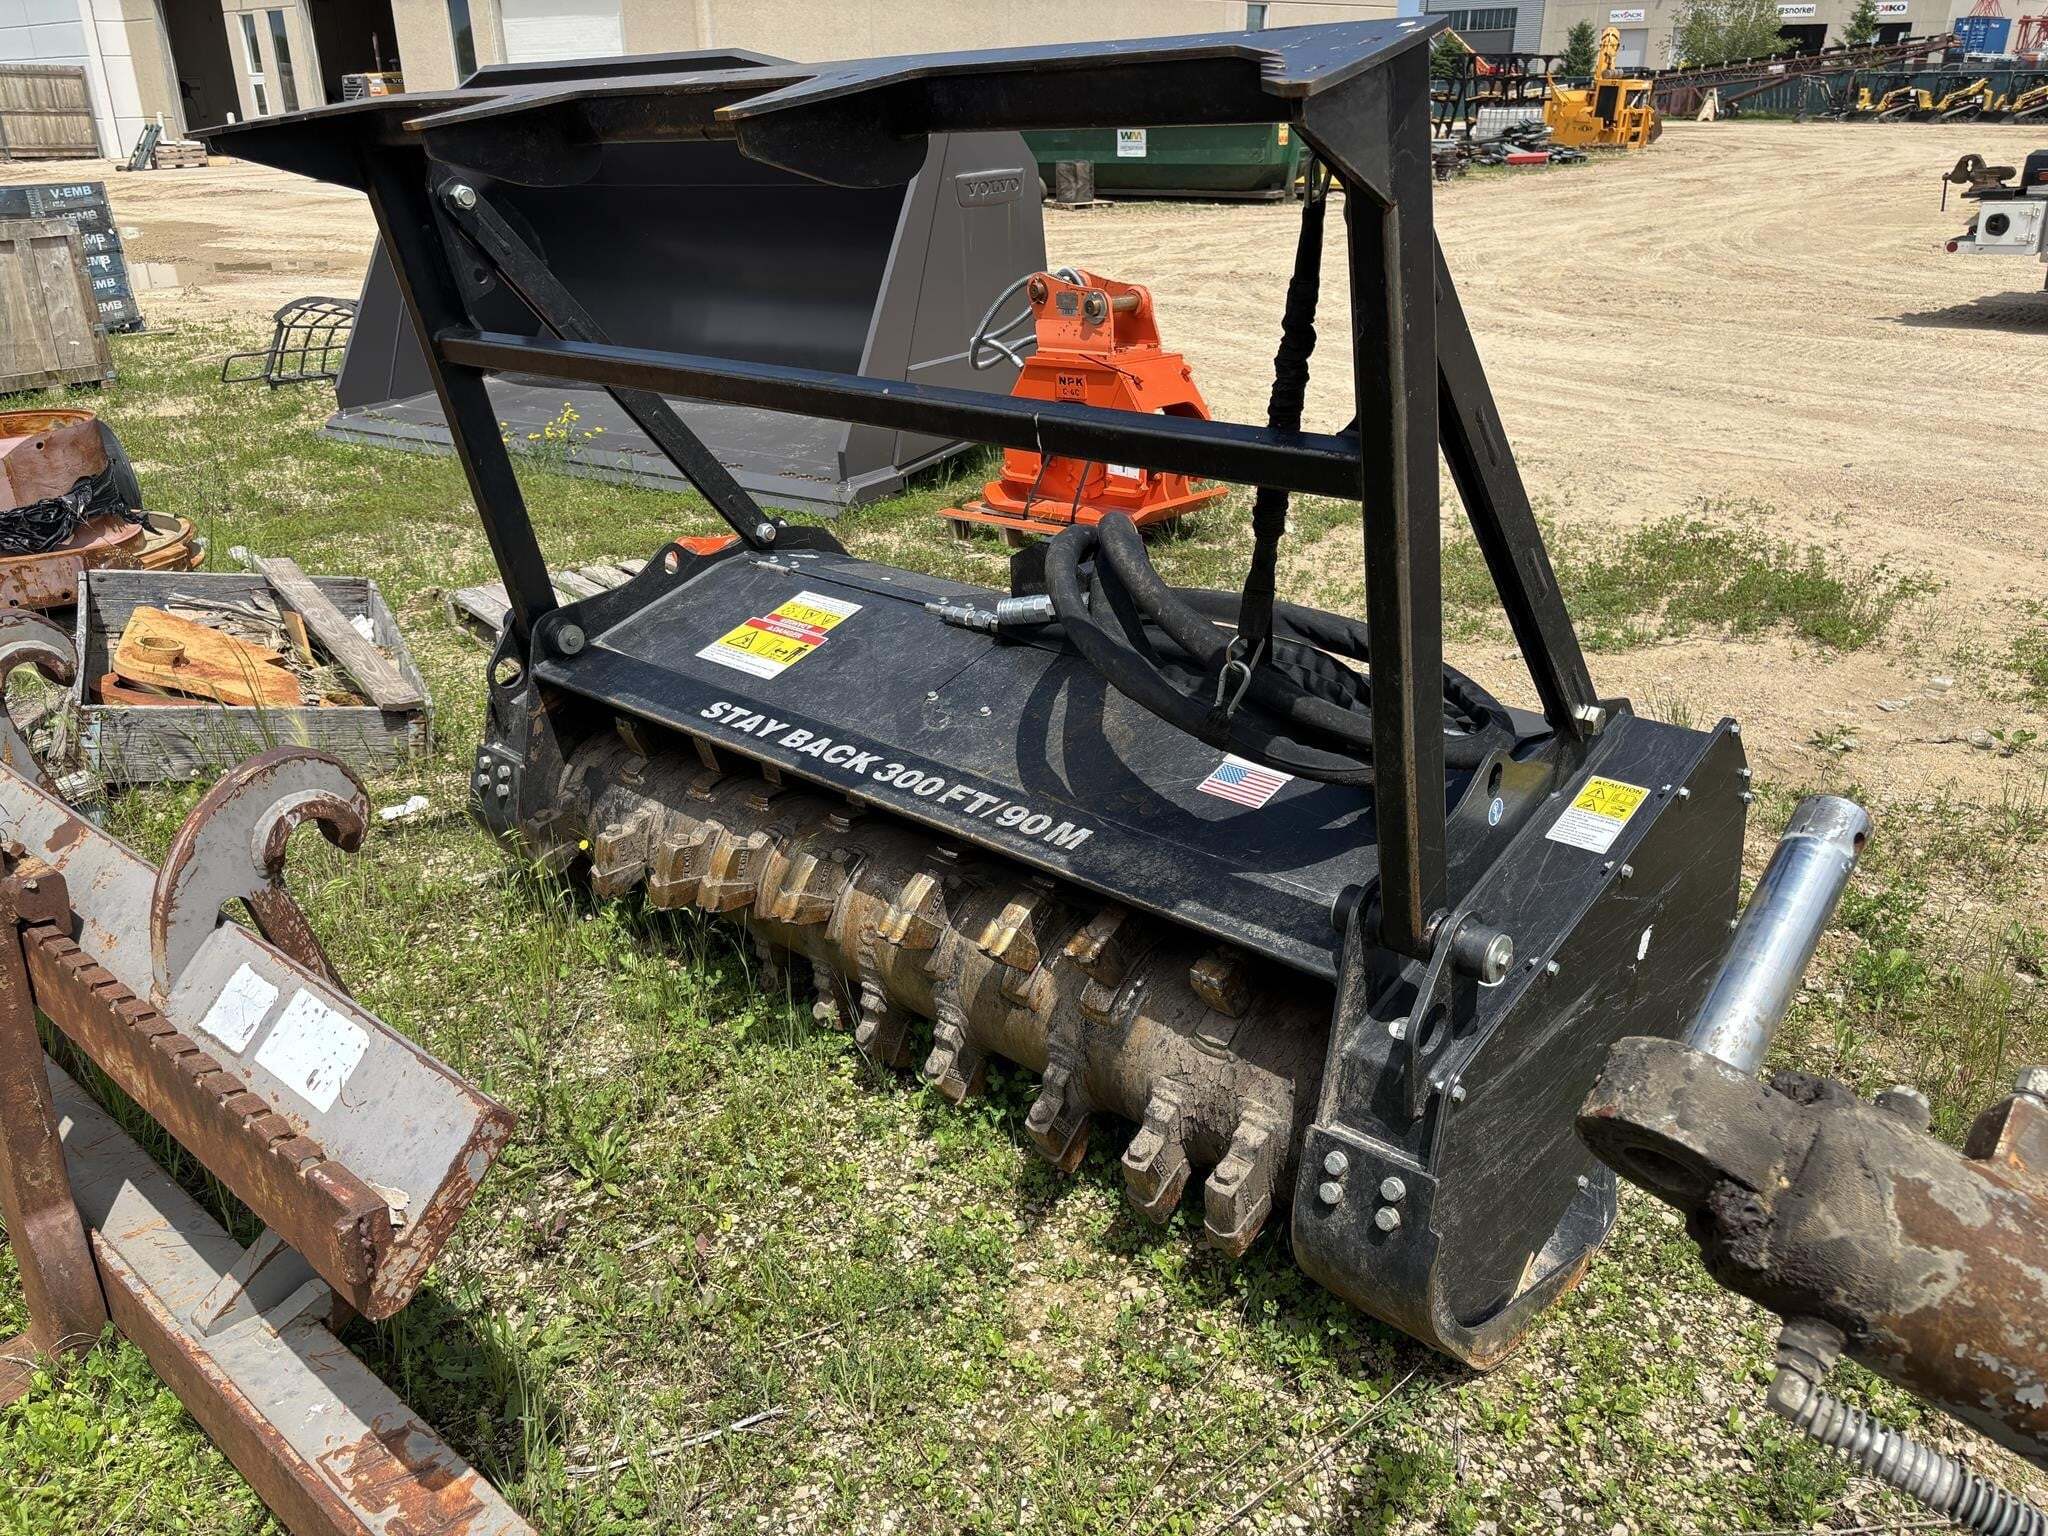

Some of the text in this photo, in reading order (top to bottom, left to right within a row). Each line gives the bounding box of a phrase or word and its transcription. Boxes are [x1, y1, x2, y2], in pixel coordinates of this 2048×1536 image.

[50, 185, 93, 199] V-EMB
[965, 178, 1019, 197] VOLVO
[1059, 376, 1083, 386] NPK
[700, 701, 791, 738] STAY
[778, 728, 885, 775] BACK
[872, 763, 946, 796] 300
[1602, 781, 1643, 795] CAUTION
